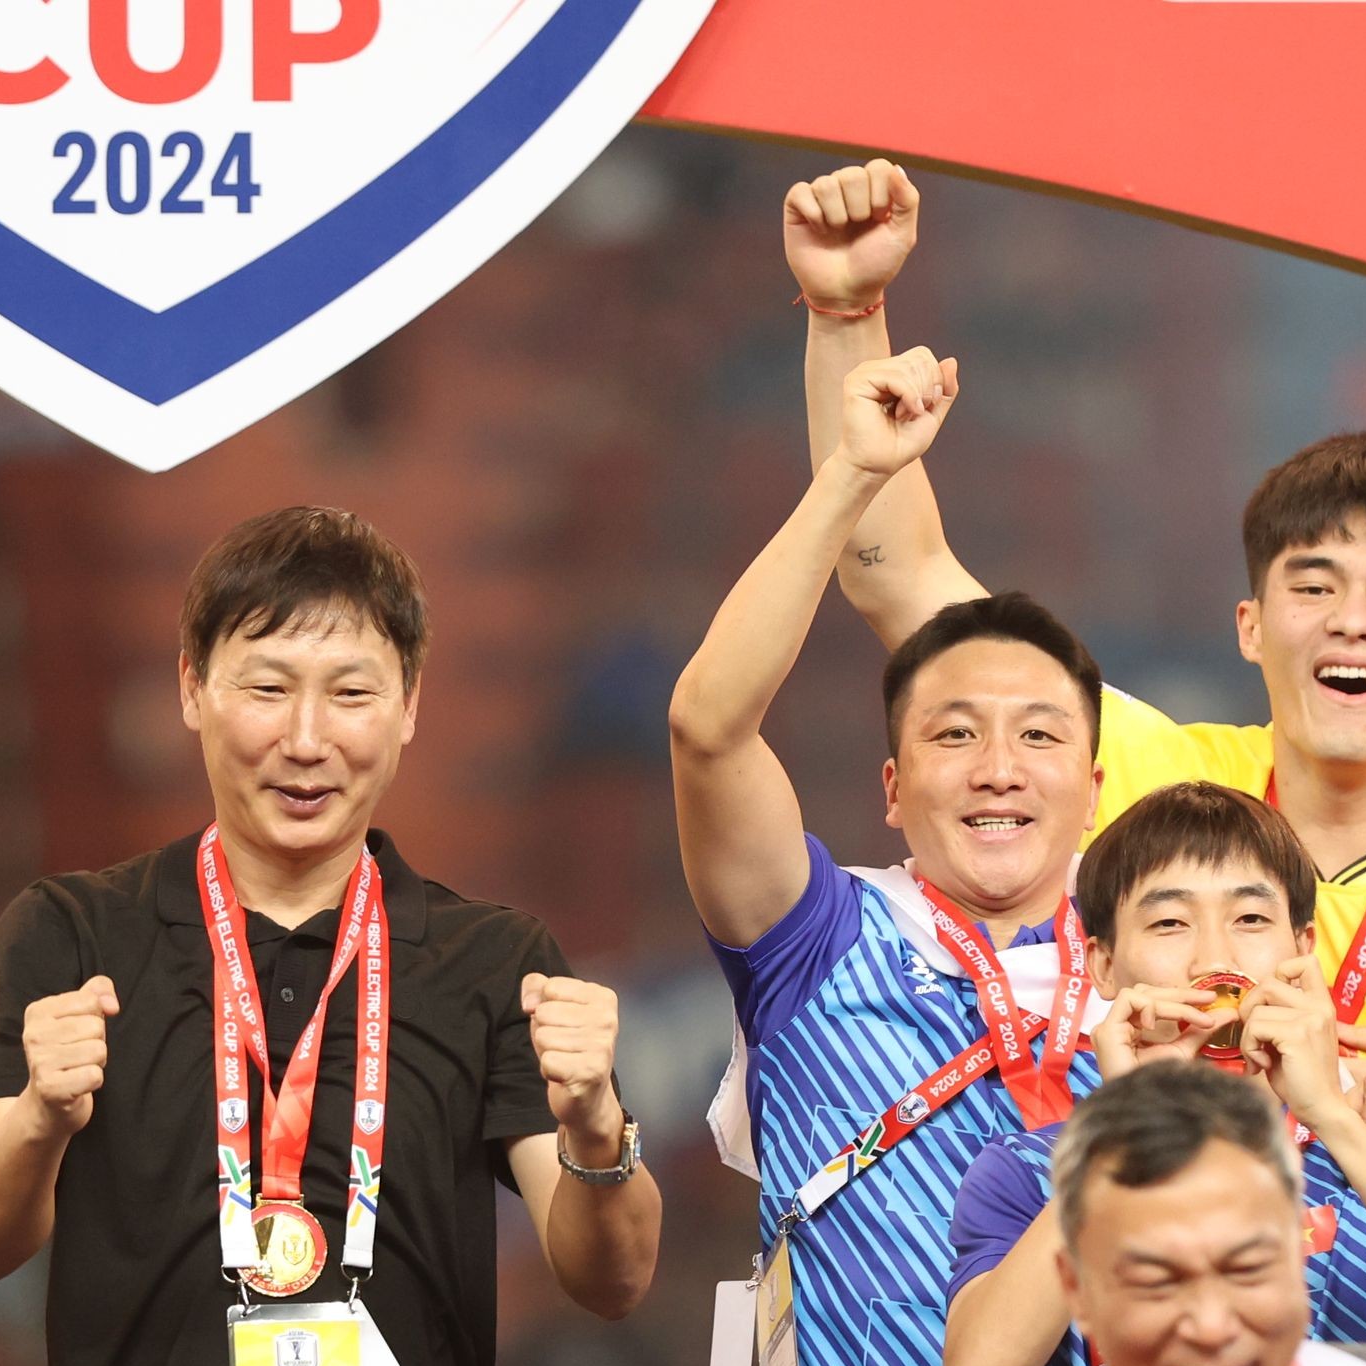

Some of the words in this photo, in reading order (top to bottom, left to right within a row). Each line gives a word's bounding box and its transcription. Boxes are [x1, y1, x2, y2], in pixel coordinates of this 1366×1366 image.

[52, 130, 263, 215] 2024
[858, 545, 886, 566] 25
[351, 856, 373, 924] MITSUBISHI
[203, 845, 228, 921] MITSUBISHI
[217, 920, 247, 991] ELECTRIC
[238, 991, 257, 1027] CUP
[366, 958, 381, 1020] ELECTRIC
[951, 924, 997, 980] ELECTRIC
[987, 981, 1009, 1017] CUP
[999, 1022, 1021, 1061] 2024
[1064, 977, 1082, 1013] CUP
[1340, 970, 1363, 1007] 2024
[223, 1021, 238, 1053] CUP
[298, 1022, 316, 1060] 2024
[366, 1021, 381, 1053] CUP
[1054, 1016, 1072, 1054] 2024
[224, 1057, 240, 1091] 2024
[364, 1056, 379, 1092] 2024
[964, 1048, 992, 1074] CUP
[929, 1069, 963, 1098] 2024
